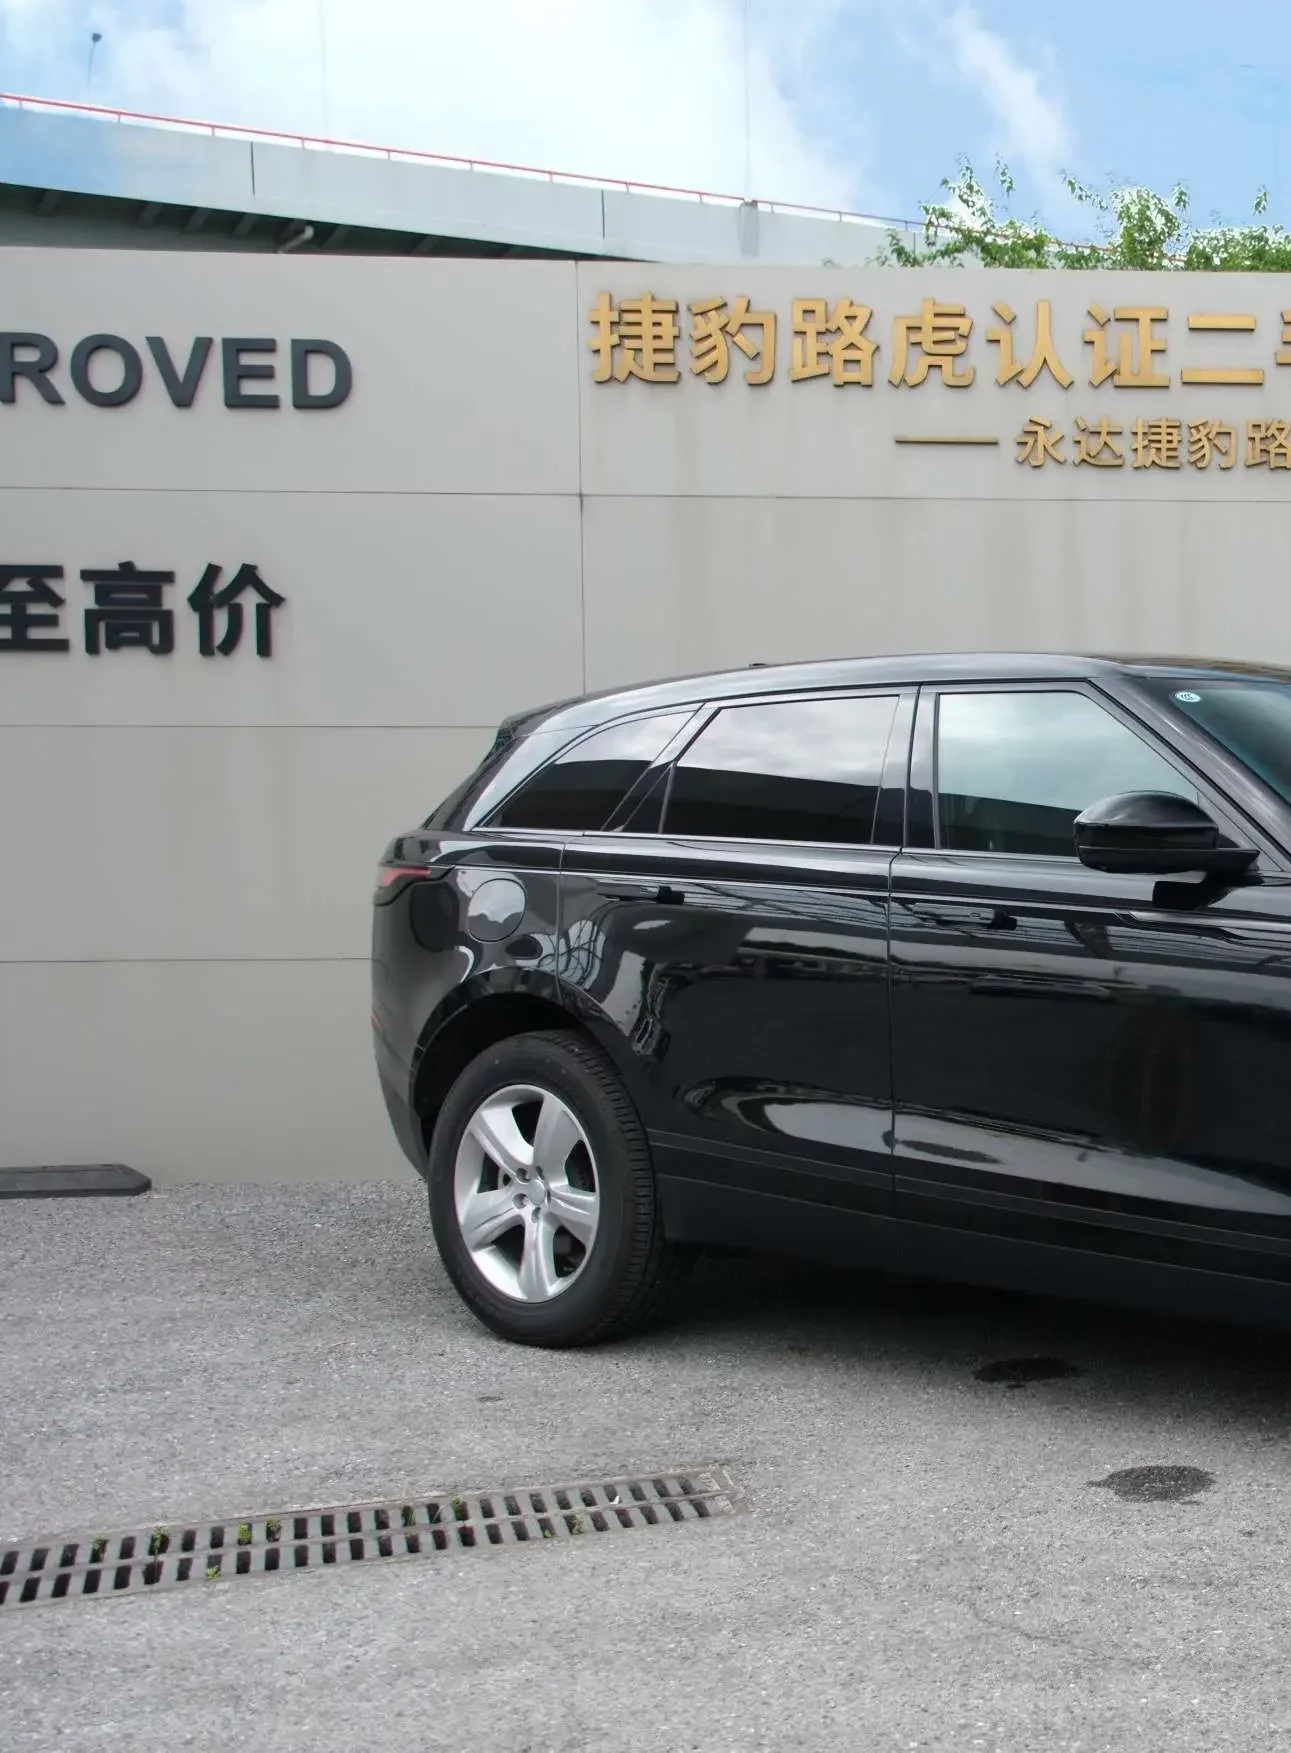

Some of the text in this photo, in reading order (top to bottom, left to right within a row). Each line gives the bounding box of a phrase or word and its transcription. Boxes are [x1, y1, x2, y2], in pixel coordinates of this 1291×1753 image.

[0, 331, 353, 410] ROVED
[0, 560, 287, 658] 至高价
